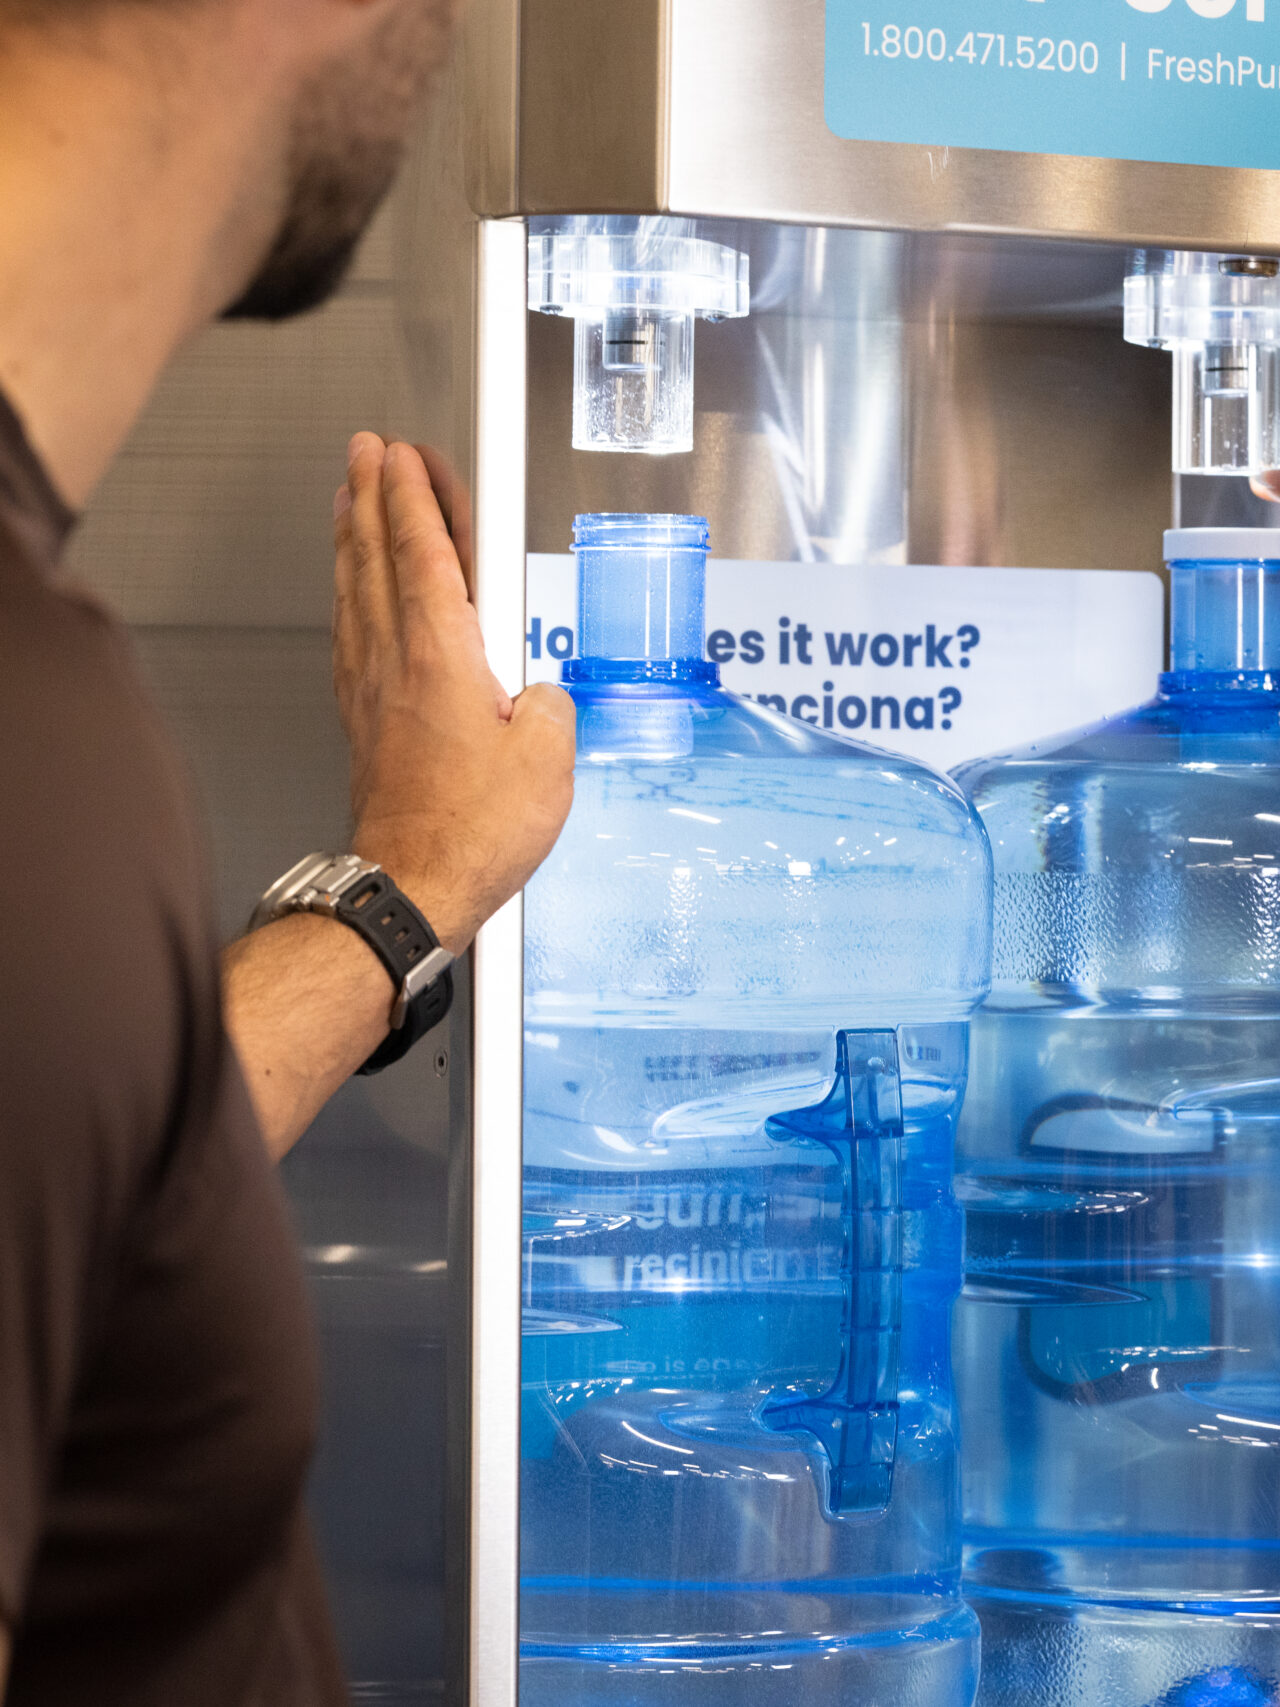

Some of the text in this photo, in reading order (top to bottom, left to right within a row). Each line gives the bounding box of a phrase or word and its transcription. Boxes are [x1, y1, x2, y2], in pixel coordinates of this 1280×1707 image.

[861, 22, 1099, 74] 1.800.471.5200
[778, 616, 813, 665] it
[824, 624, 980, 668] work?
